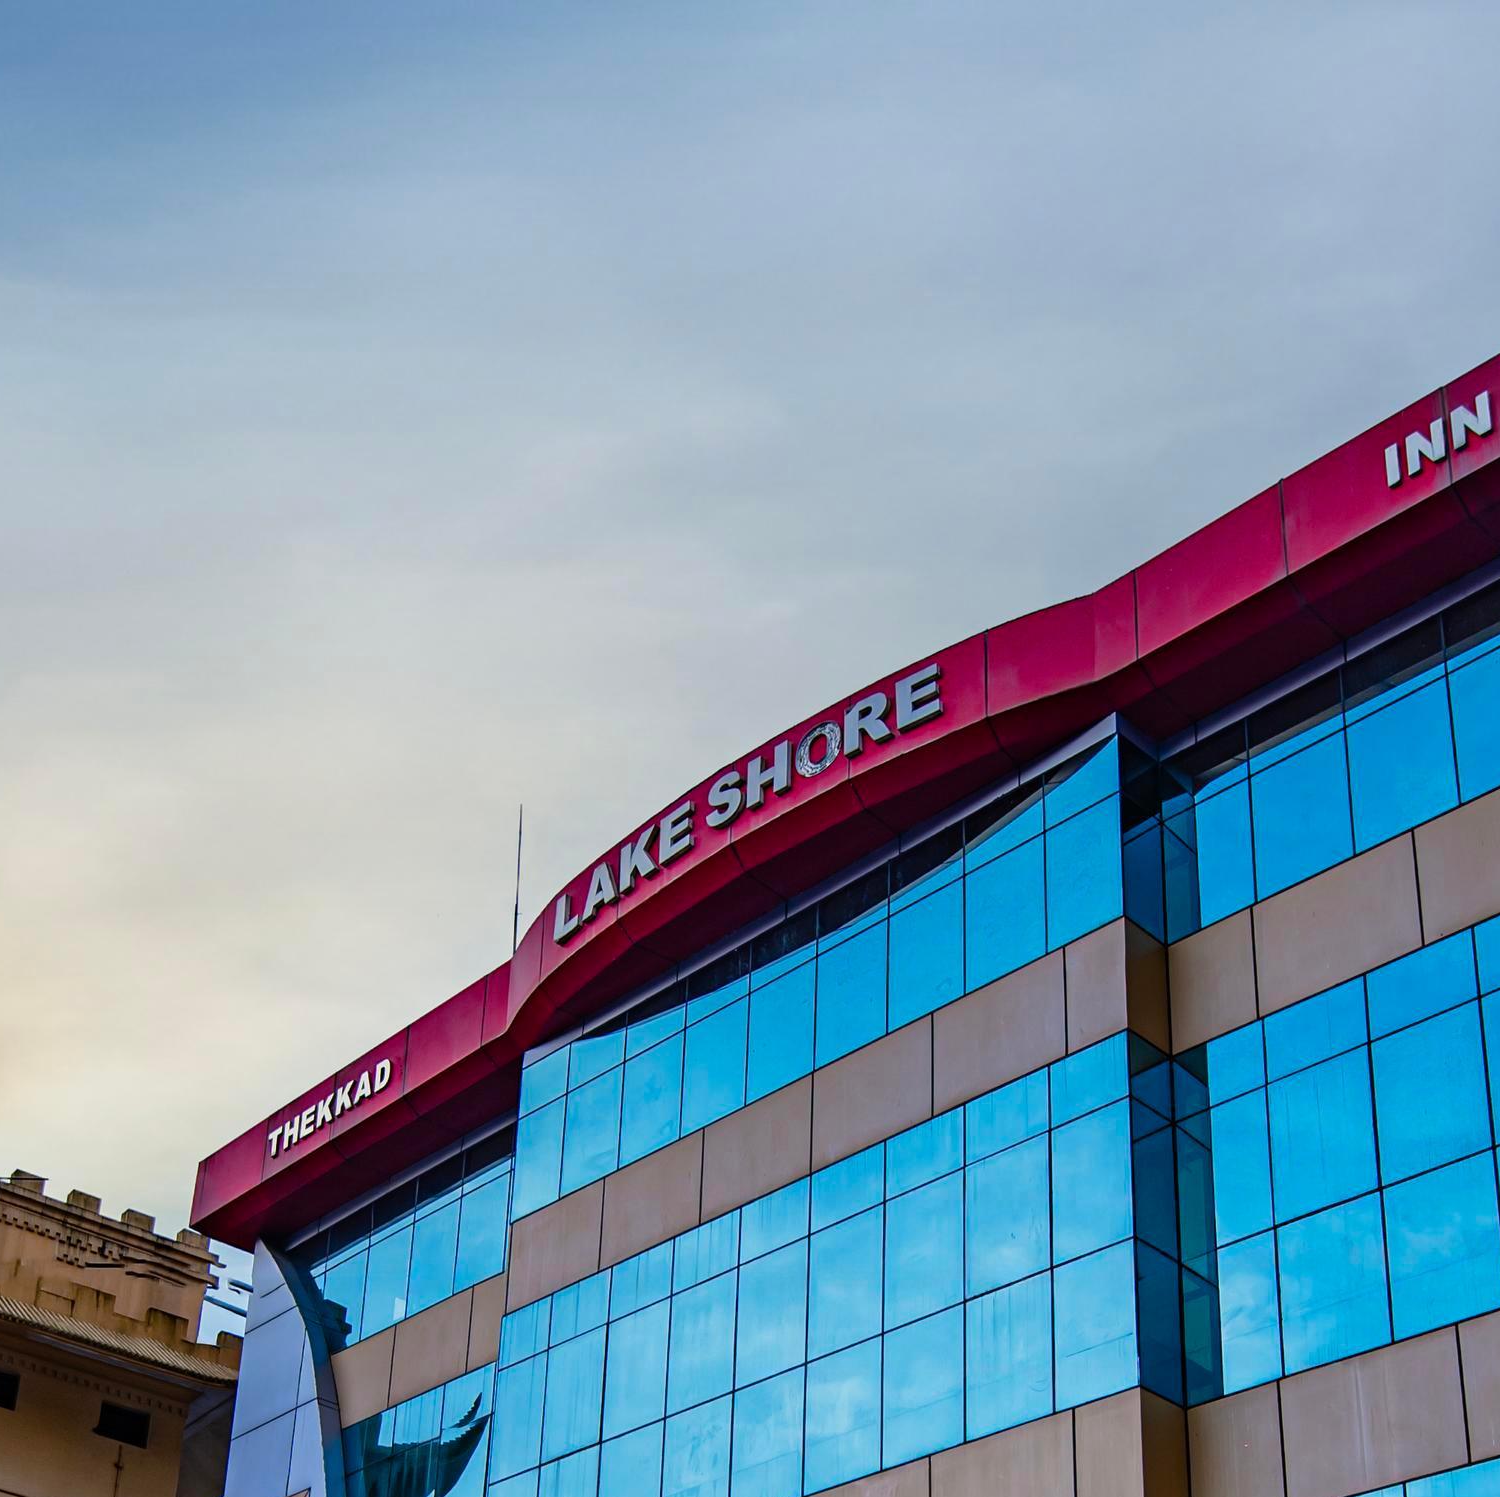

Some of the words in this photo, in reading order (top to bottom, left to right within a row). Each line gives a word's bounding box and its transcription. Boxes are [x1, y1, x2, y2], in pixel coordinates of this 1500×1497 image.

[267, 1059, 392, 1159] THEKKAD
[553, 802, 696, 946] LAKE
[705, 662, 944, 830] SHORE
[1382, 391, 1492, 488] INN
